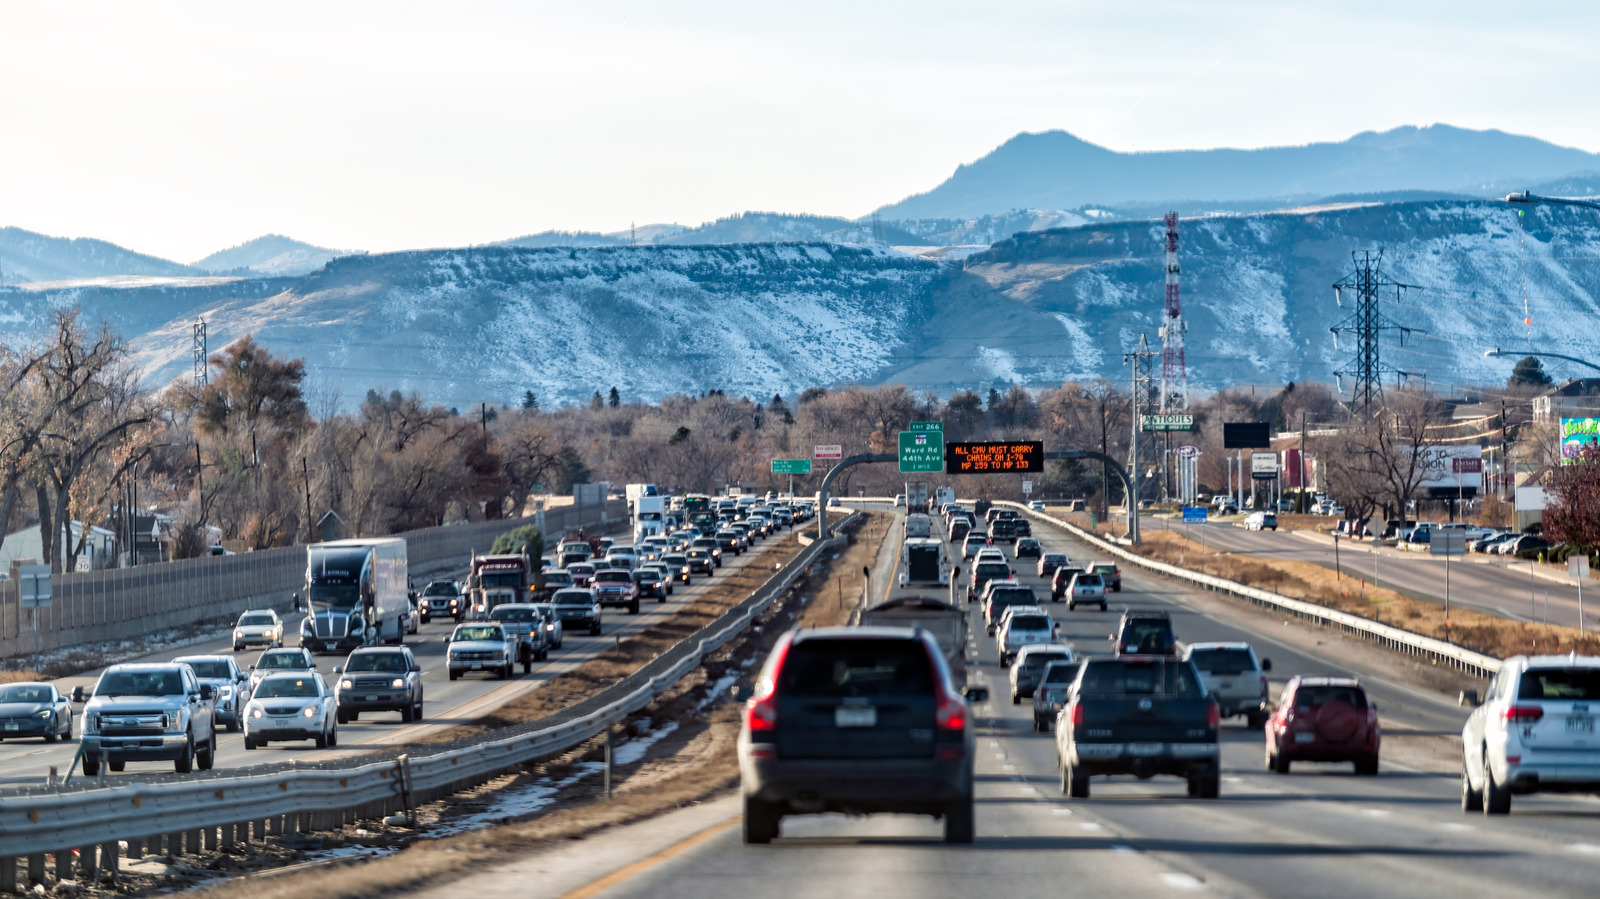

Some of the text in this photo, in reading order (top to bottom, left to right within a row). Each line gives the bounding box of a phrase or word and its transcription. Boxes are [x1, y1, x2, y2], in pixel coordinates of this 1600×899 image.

[1144, 415, 1192, 424] ANTIQUES
[956, 446, 968, 454] ALL
[1011, 445, 1033, 453] CARRY
[1435, 450, 1447, 458] TO
